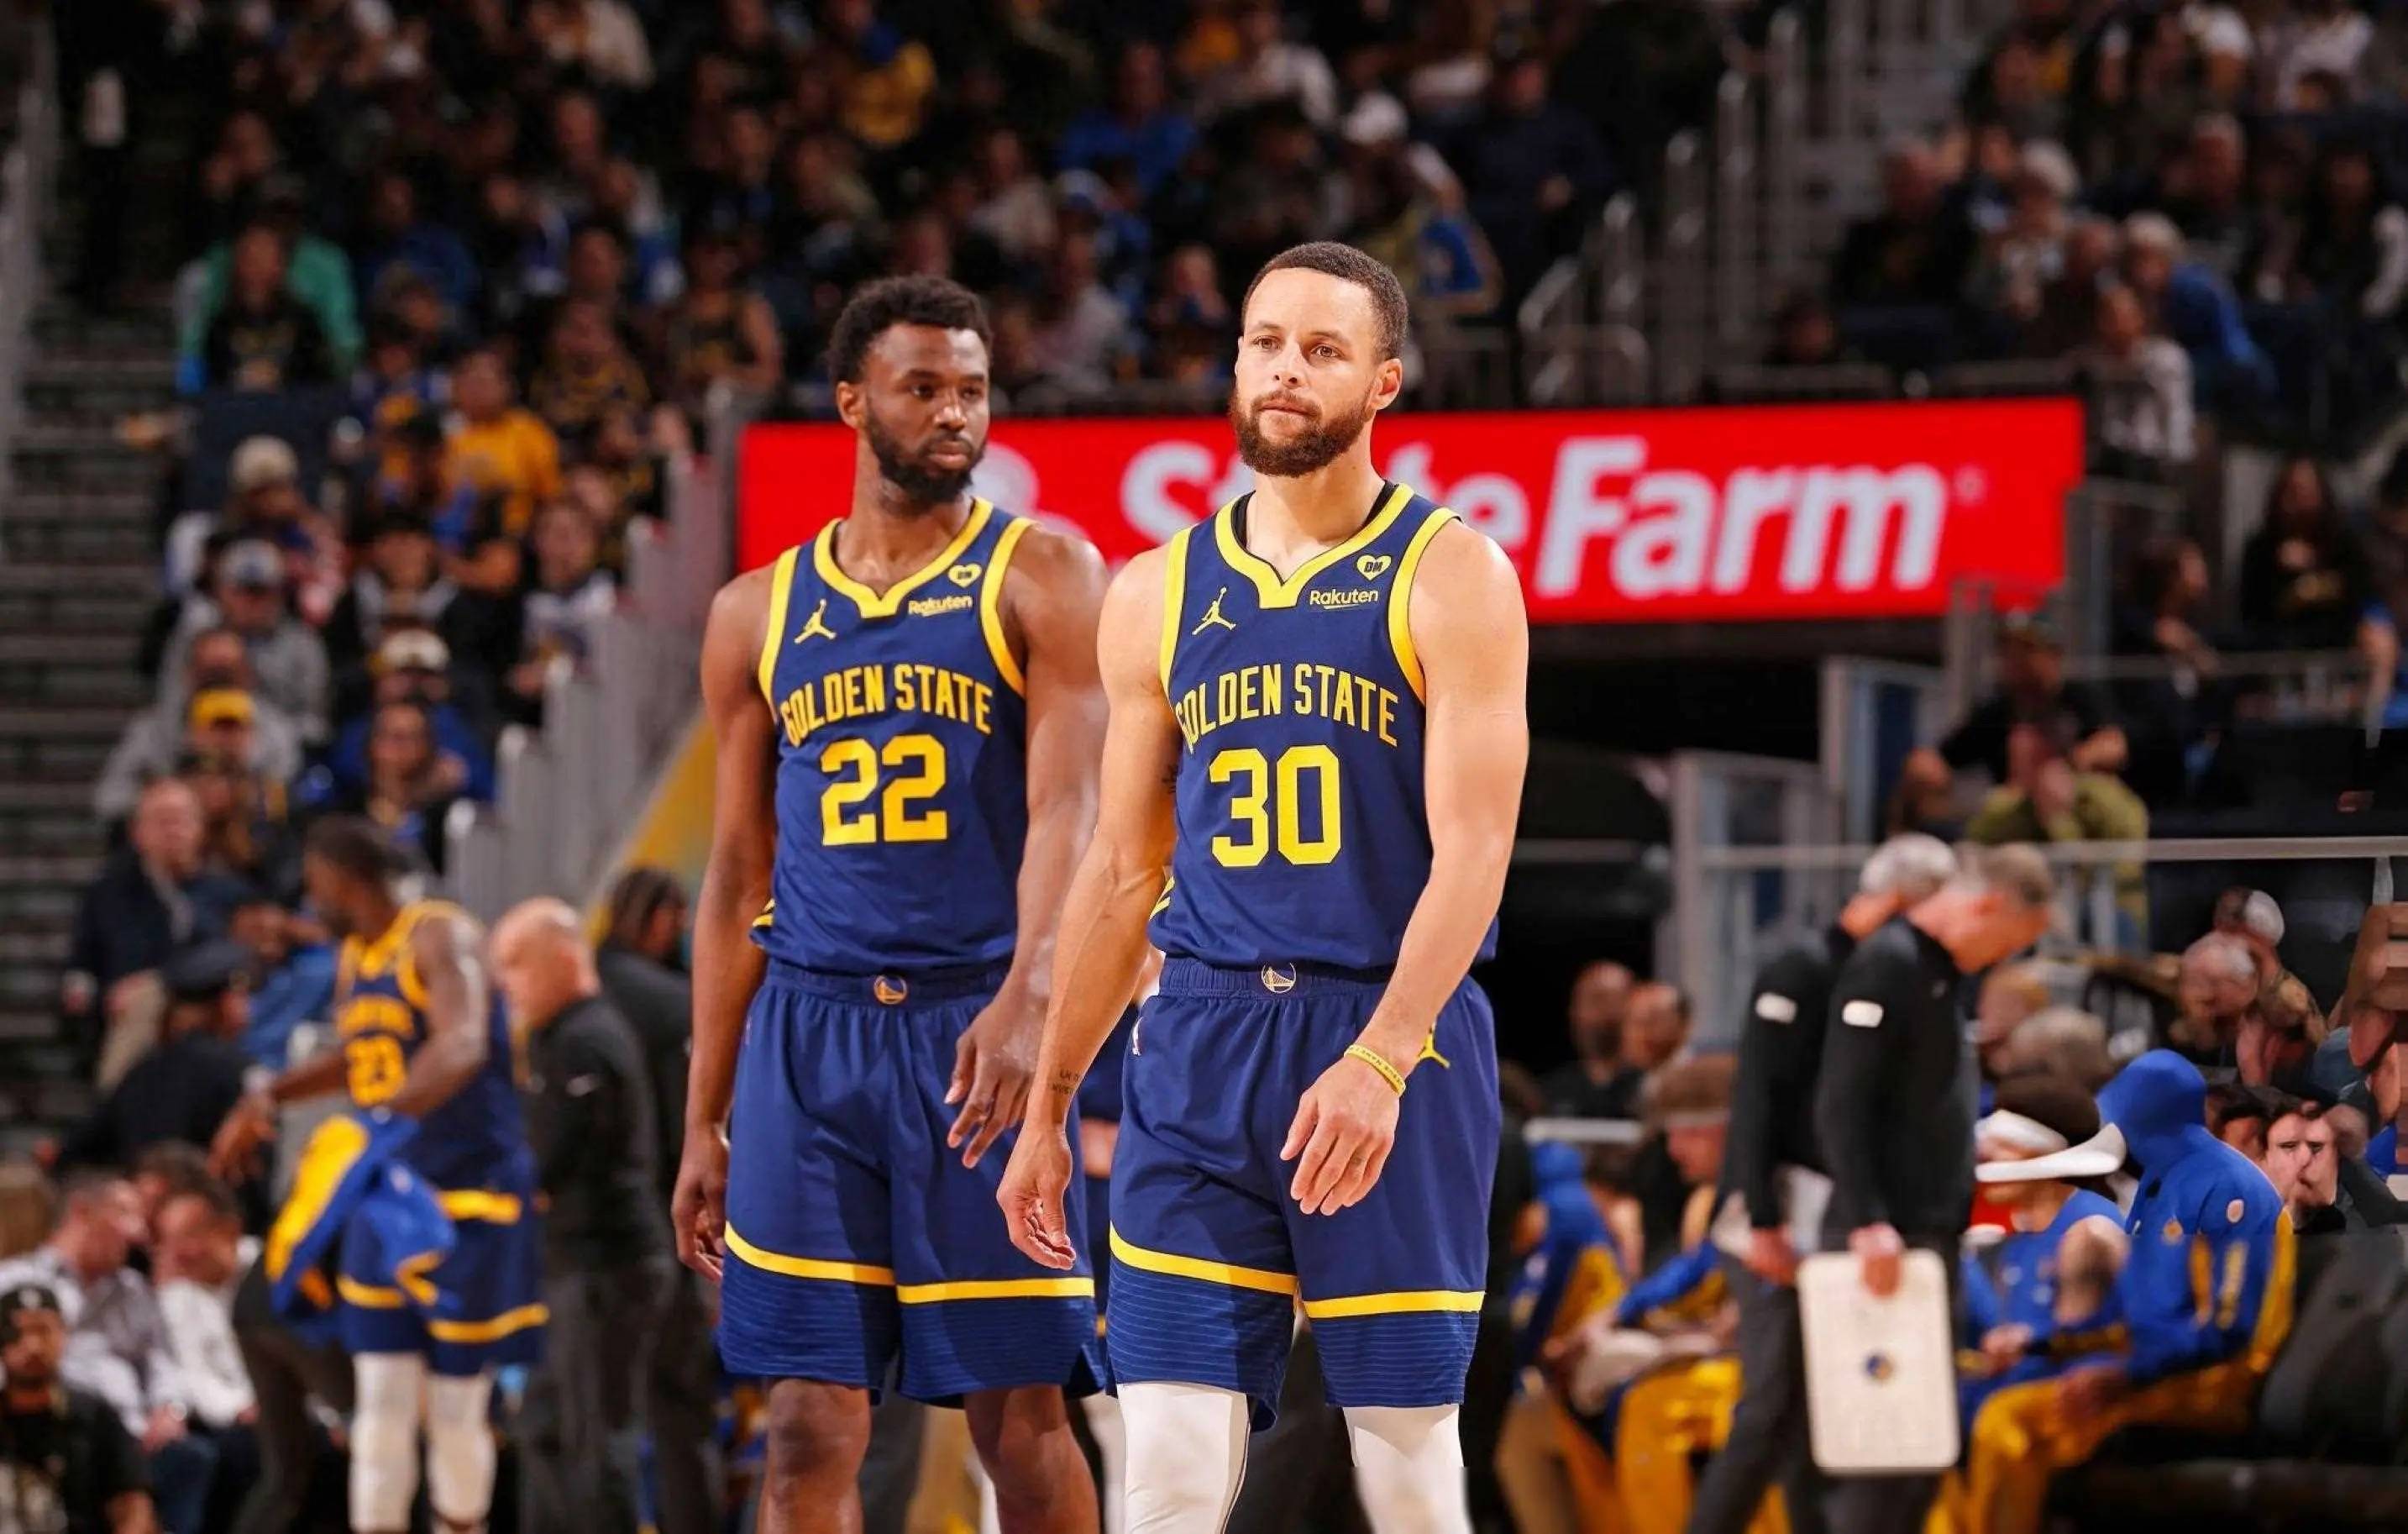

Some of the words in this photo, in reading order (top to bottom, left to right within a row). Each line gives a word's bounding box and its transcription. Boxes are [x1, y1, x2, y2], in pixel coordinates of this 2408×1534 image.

[1535, 434, 1948, 598] Farm
[1309, 588, 1379, 605] Rakuten
[779, 664, 886, 748] GOLDEN
[894, 663, 993, 735] STATE
[1294, 663, 1398, 747] STATE
[820, 733, 947, 847] 22
[1209, 744, 1341, 867] 30
